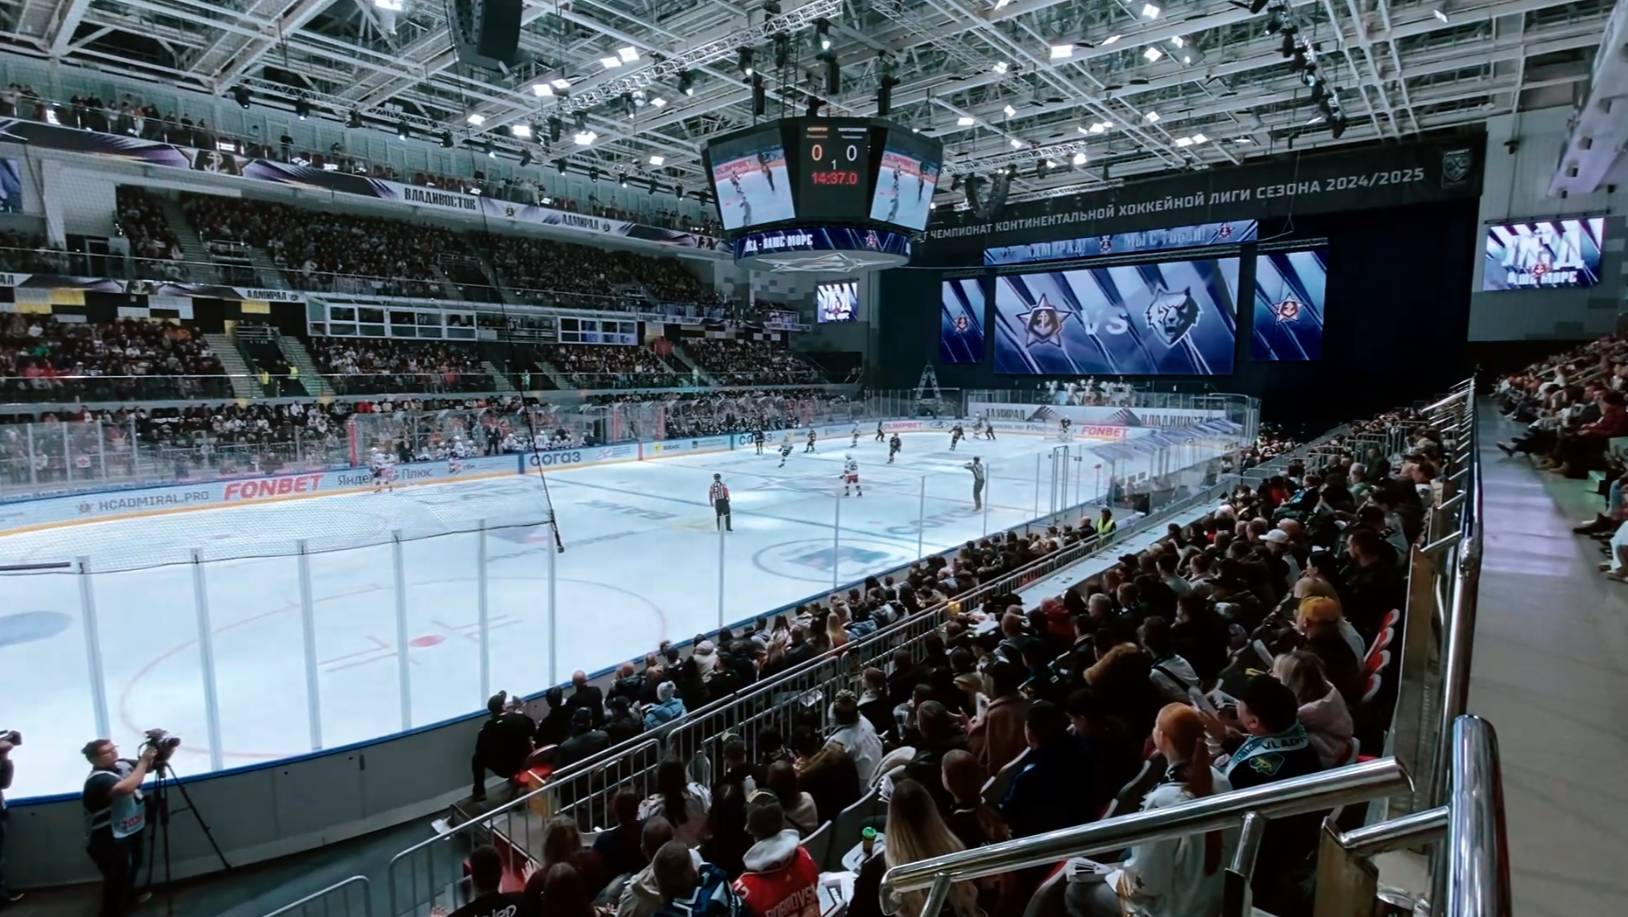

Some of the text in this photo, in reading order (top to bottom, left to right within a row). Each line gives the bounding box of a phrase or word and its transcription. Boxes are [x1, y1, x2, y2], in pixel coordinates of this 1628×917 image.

[811, 144, 858, 161] 0 0
[831, 159, 837, 170] 1
[811, 171, 858, 185] 14:37.0
[404, 187, 476, 210] ВЛАДИВОСТОК
[930, 223, 993, 239] ЧЕМПИОНАТ
[995, 204, 1115, 231] КОНТИНЕНТАЛЬНОЙ
[1118, 192, 1204, 217] ХОККЕЙНОЙ
[1209, 188, 1250, 204] ЛИГИ
[1256, 180, 1321, 198] СЕЗОНА
[1326, 168, 1424, 191] 2024/2025
[562, 214, 599, 230] АДМИРАЛ
[787, 234, 813, 247] МОРЕ
[1082, 425, 1128, 438] FONBET
[401, 468, 433, 481] Плюс
[224, 475, 324, 500] FONBET
[100, 490, 210, 512] HCADMIRAL.PRO
